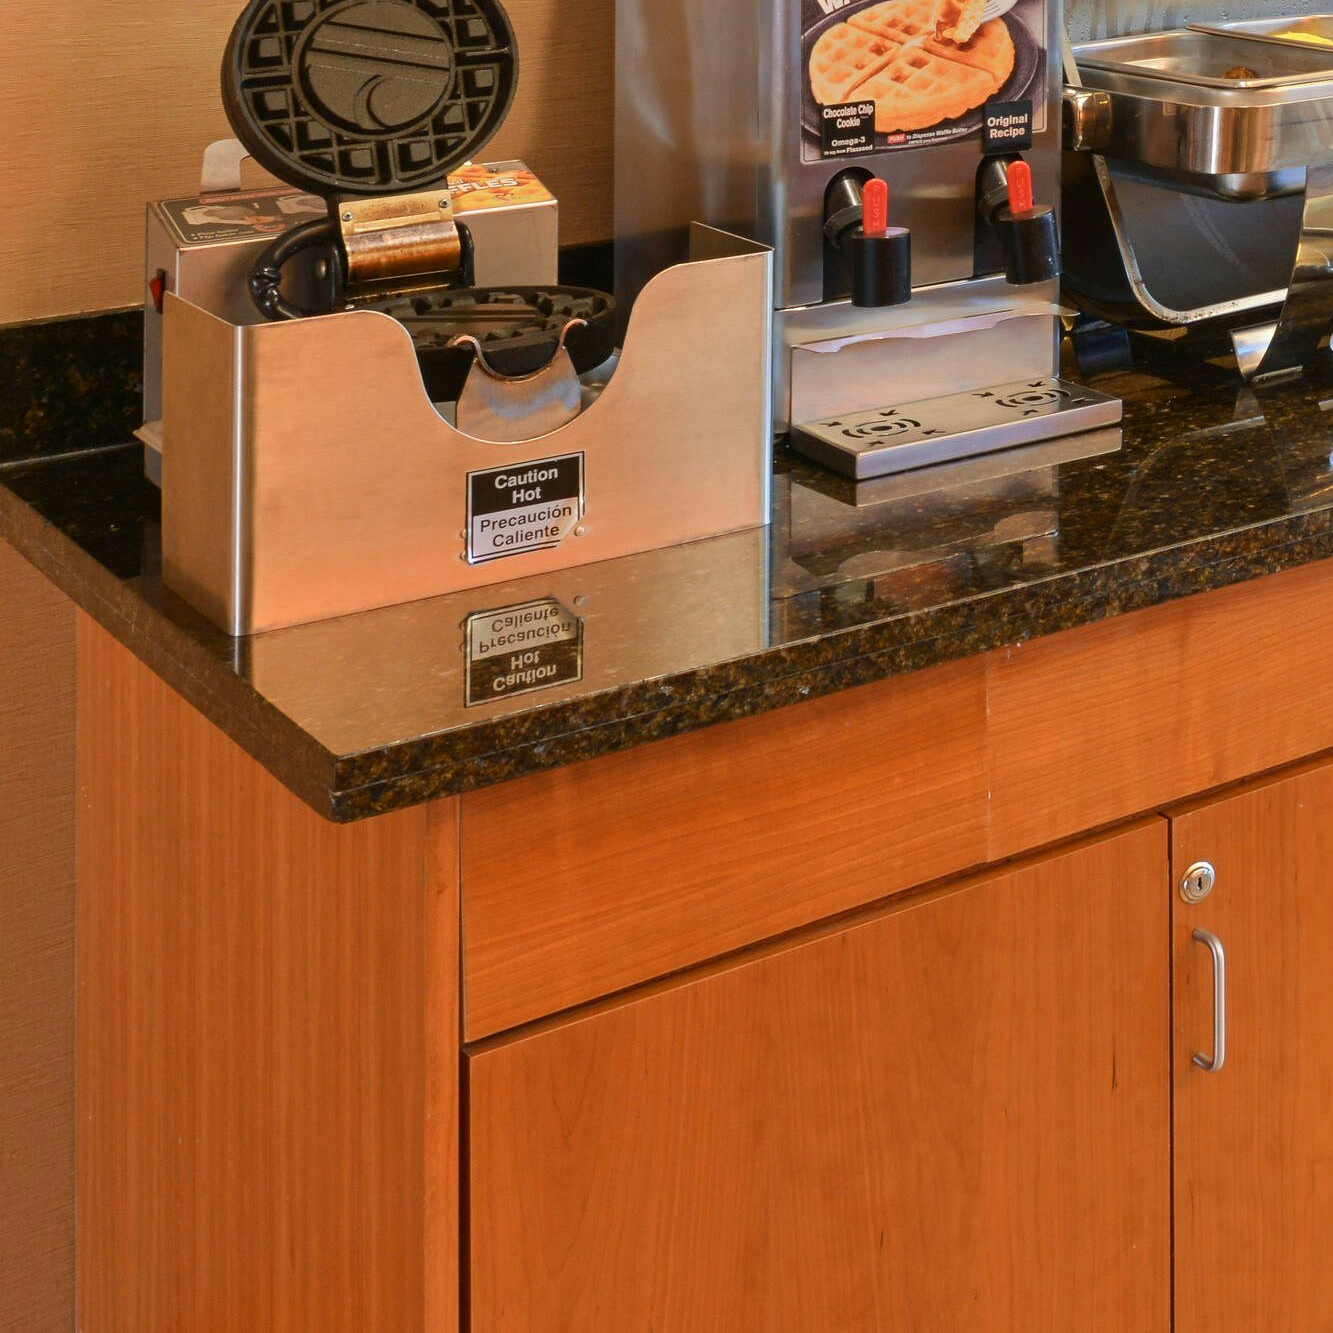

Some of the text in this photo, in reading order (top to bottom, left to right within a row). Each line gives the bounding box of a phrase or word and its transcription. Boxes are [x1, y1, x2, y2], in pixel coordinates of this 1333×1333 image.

[823, 104, 873, 118] Chocolate Chip
[836, 117, 860, 128] Cookie
[987, 114, 1028, 127] Original
[990, 127, 1025, 138] Recipe
[831, 136, 865, 147] Omega-3
[846, 145, 873, 153] Flaxseed
[494, 467, 558, 489] Caution
[512, 486, 541, 504] Hot
[480, 504, 572, 533] Precaución
[492, 525, 560, 547] Caliente
